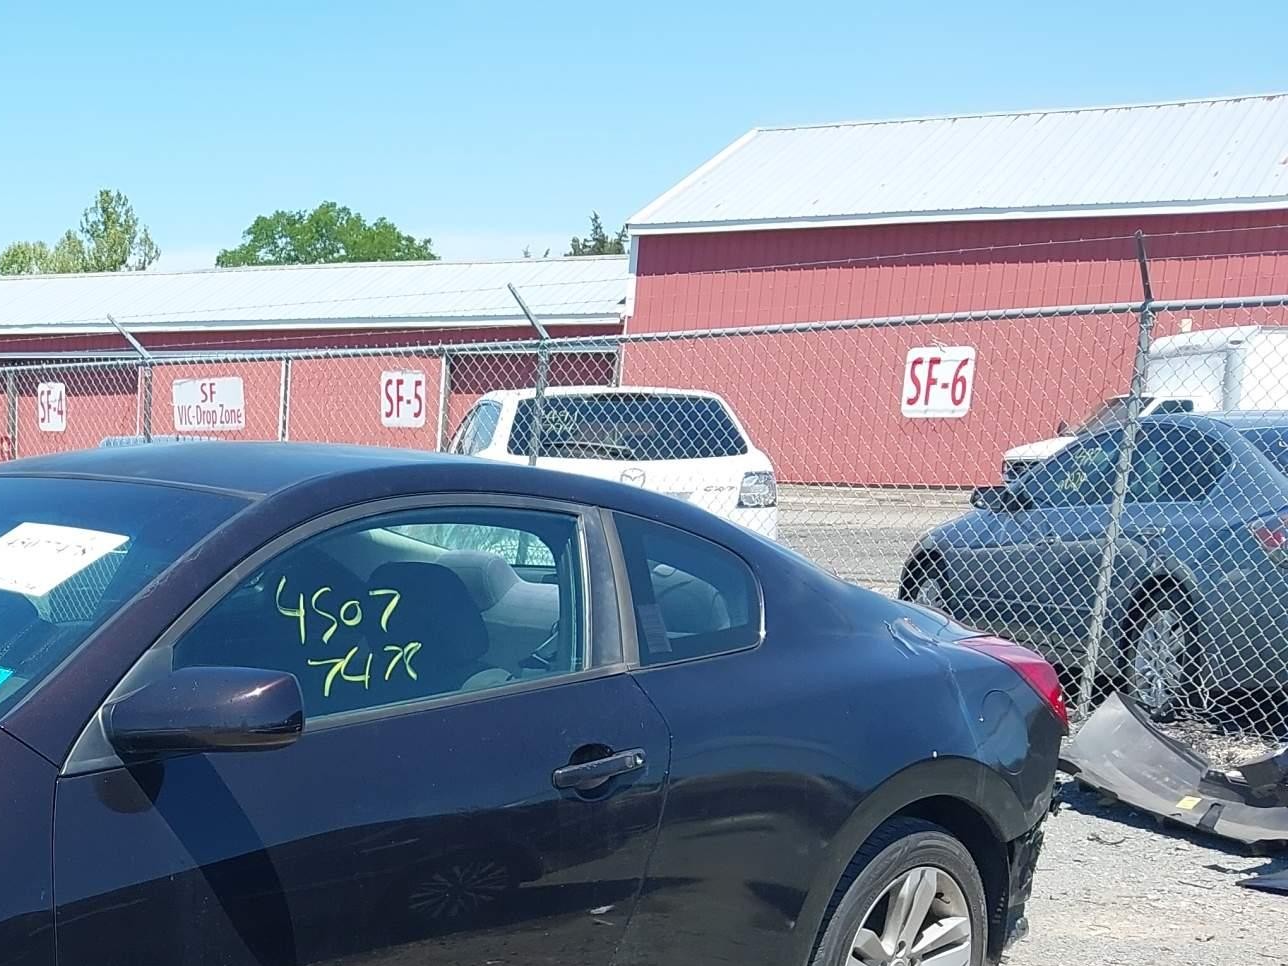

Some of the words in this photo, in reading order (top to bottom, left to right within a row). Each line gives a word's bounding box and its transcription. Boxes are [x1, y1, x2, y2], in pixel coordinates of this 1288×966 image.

[200, 382, 216, 404] SF
[384, 378, 423, 418] SF-5
[906, 356, 969, 406] SF-6
[40, 389, 64, 424] SF-4
[177, 404, 217, 426] VIC-Drop
[219, 404, 243, 424] Zone
[275, 575, 401, 644] 4507
[307, 642, 422, 697] 7478
